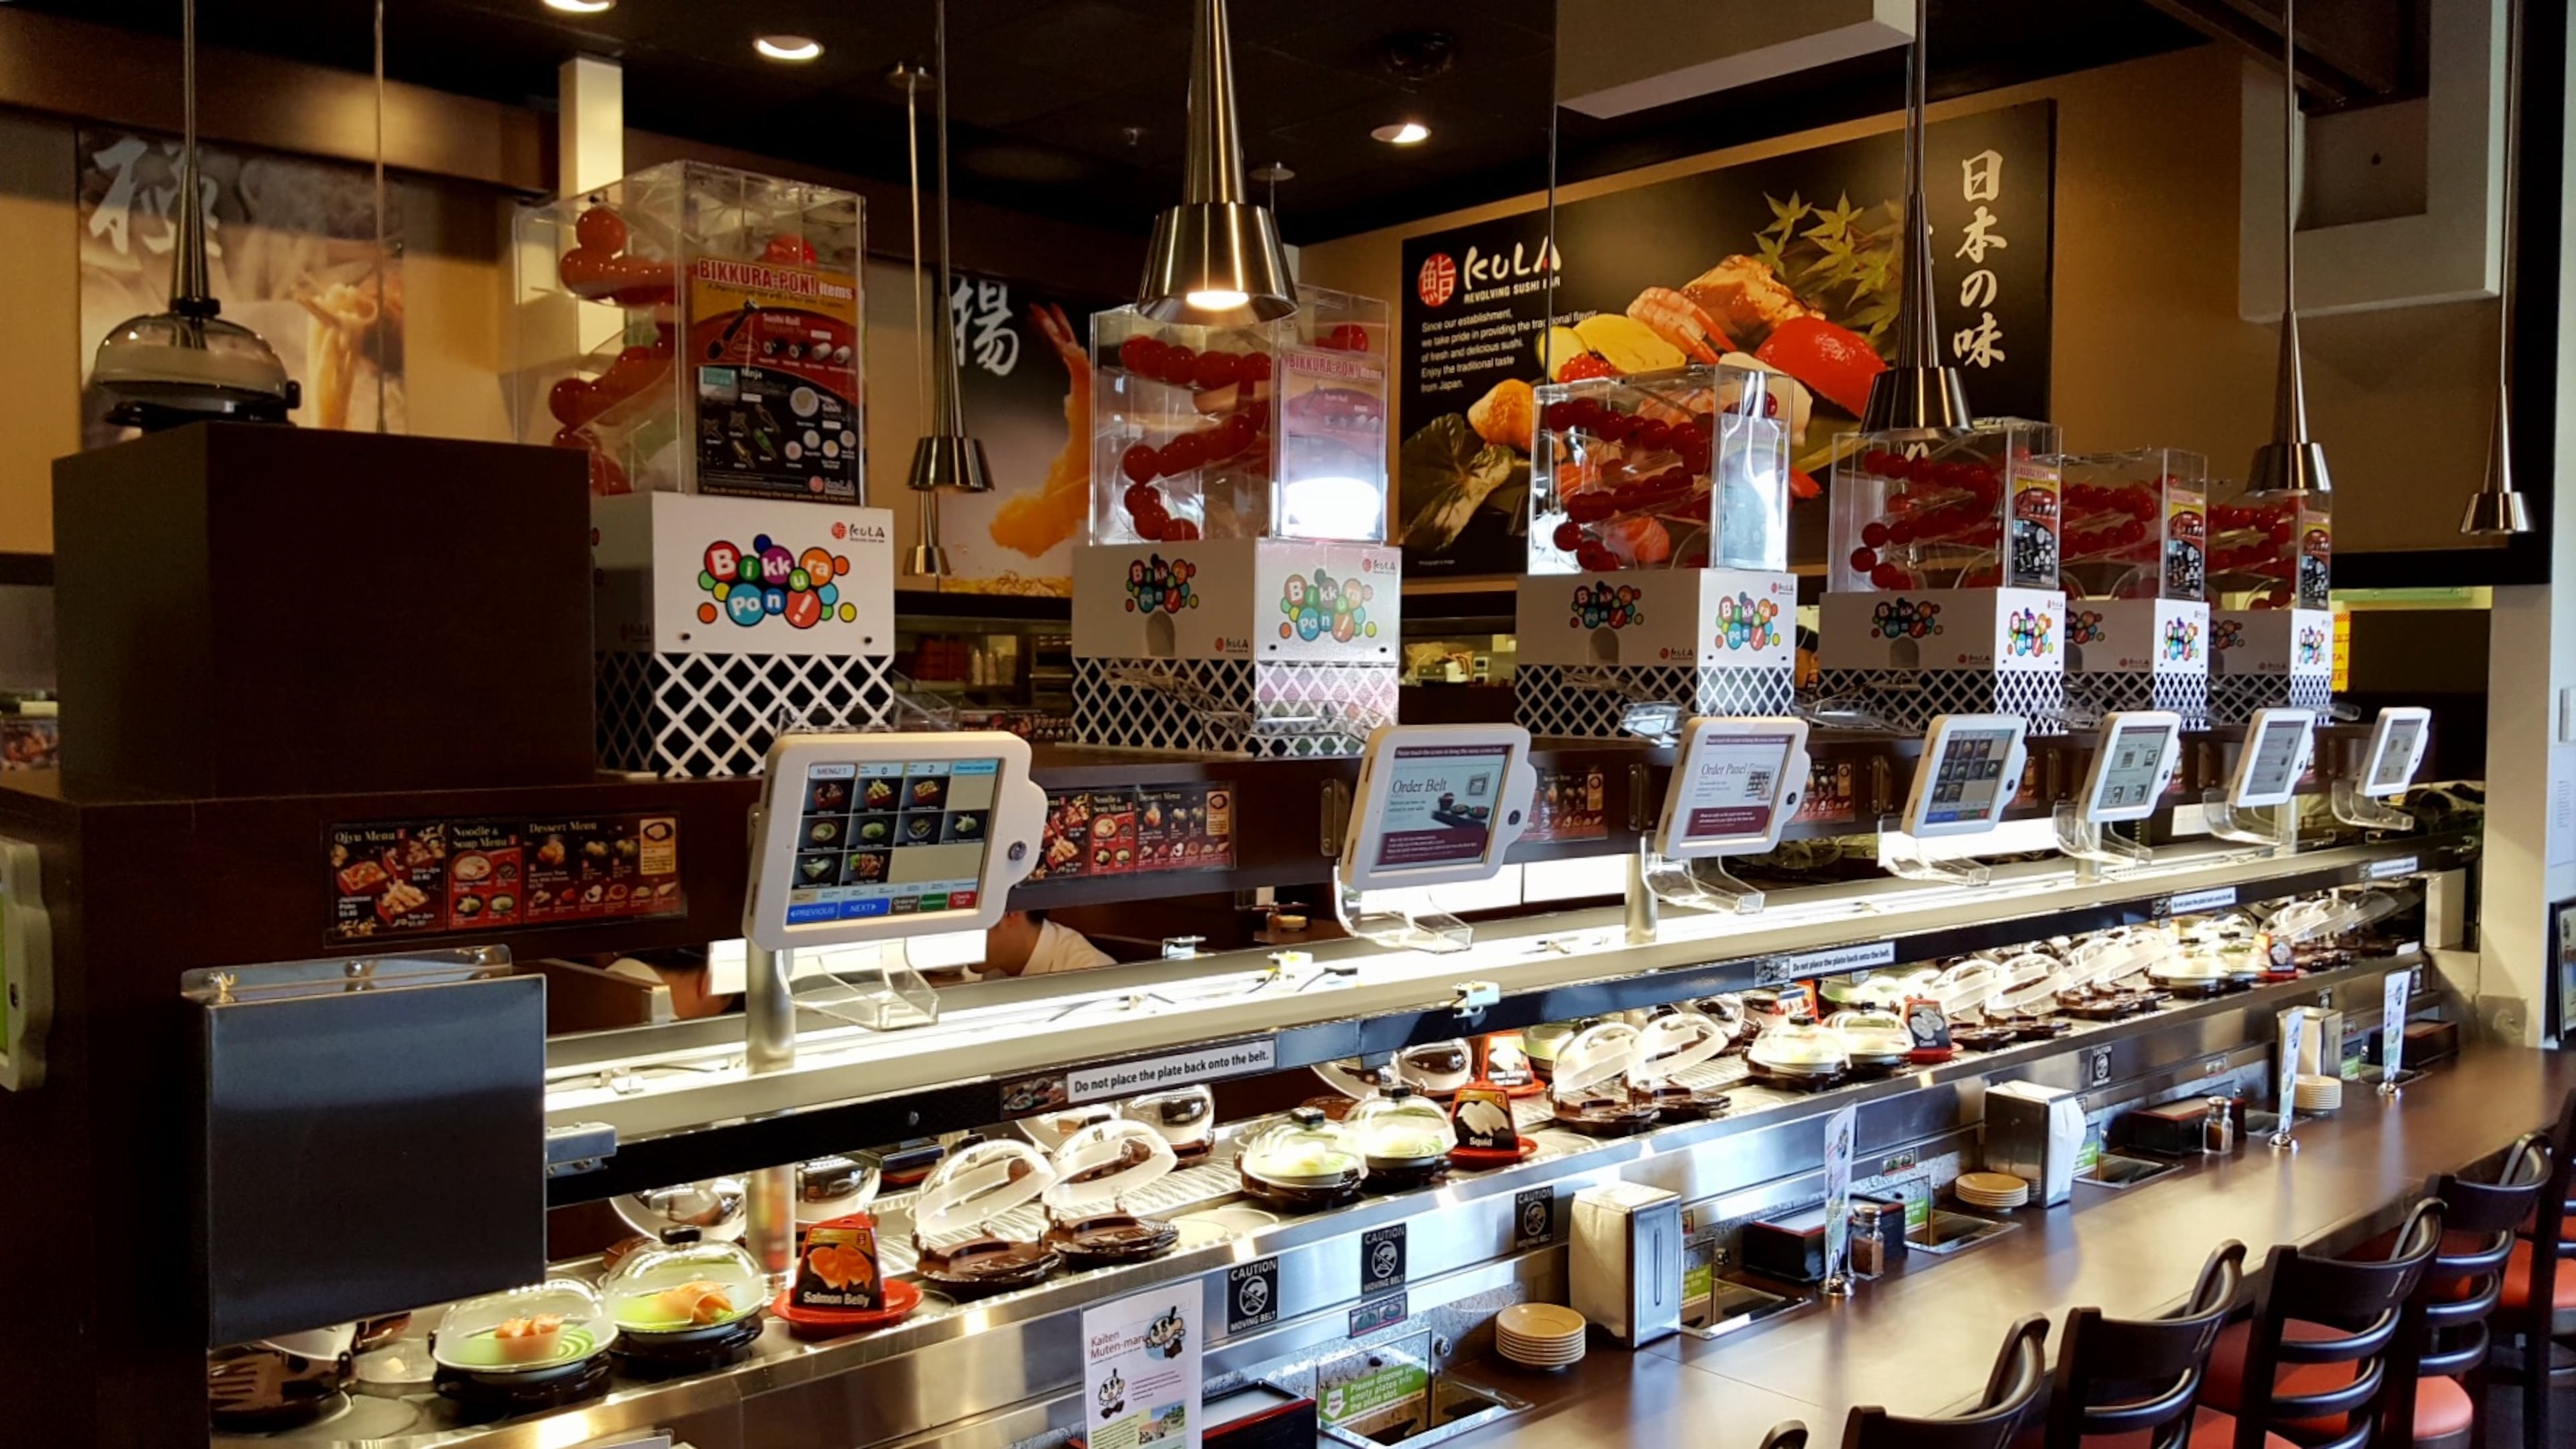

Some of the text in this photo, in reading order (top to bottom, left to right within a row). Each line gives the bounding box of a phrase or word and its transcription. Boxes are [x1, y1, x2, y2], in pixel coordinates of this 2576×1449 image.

[1953, 149, 2007, 368] 日本の味
[1419, 254, 1456, 305] 鮨
[1464, 286, 1509, 304] REVOLVING
[1513, 280, 1540, 294] SUSHI
[952, 277, 1019, 376] 揚
[1421, 309, 1513, 333] Since our establishment,
[1434, 335, 1450, 346] take
[1451, 331, 1470, 345] pride
[1472, 329, 1479, 340] in
[1481, 323, 1516, 341] providing
[1518, 321, 1530, 331] the
[1450, 347, 1464, 358] and
[1466, 342, 1499, 356] delicious
[1421, 356, 1515, 378] Enjoy the traditional taste
[1421, 379, 1464, 392] from Japan.
[928, 765, 934, 773] 2
[1701, 763, 1748, 776] Order Panel
[1392, 778, 1447, 794] Order Belt
[529, 821, 597, 834] Dessert Menu
[796, 904, 871, 918] PREVIOUS NEXT
[1075, 1049, 1269, 1093] Do not place the plate back onto the belt.
[1469, 1137, 1493, 1147] Squid
[1517, 1188, 1553, 1204] CAUTION
[1364, 1226, 1405, 1245] CAUTION
[1230, 1259, 1277, 1281] CAUTION
[1363, 1275, 1405, 1292] MOVING BELT
[803, 1291, 870, 1307] Salmon Belly
[1230, 1311, 1277, 1332] MOVING BELT
[1091, 1331, 1120, 1348] Kaiten
